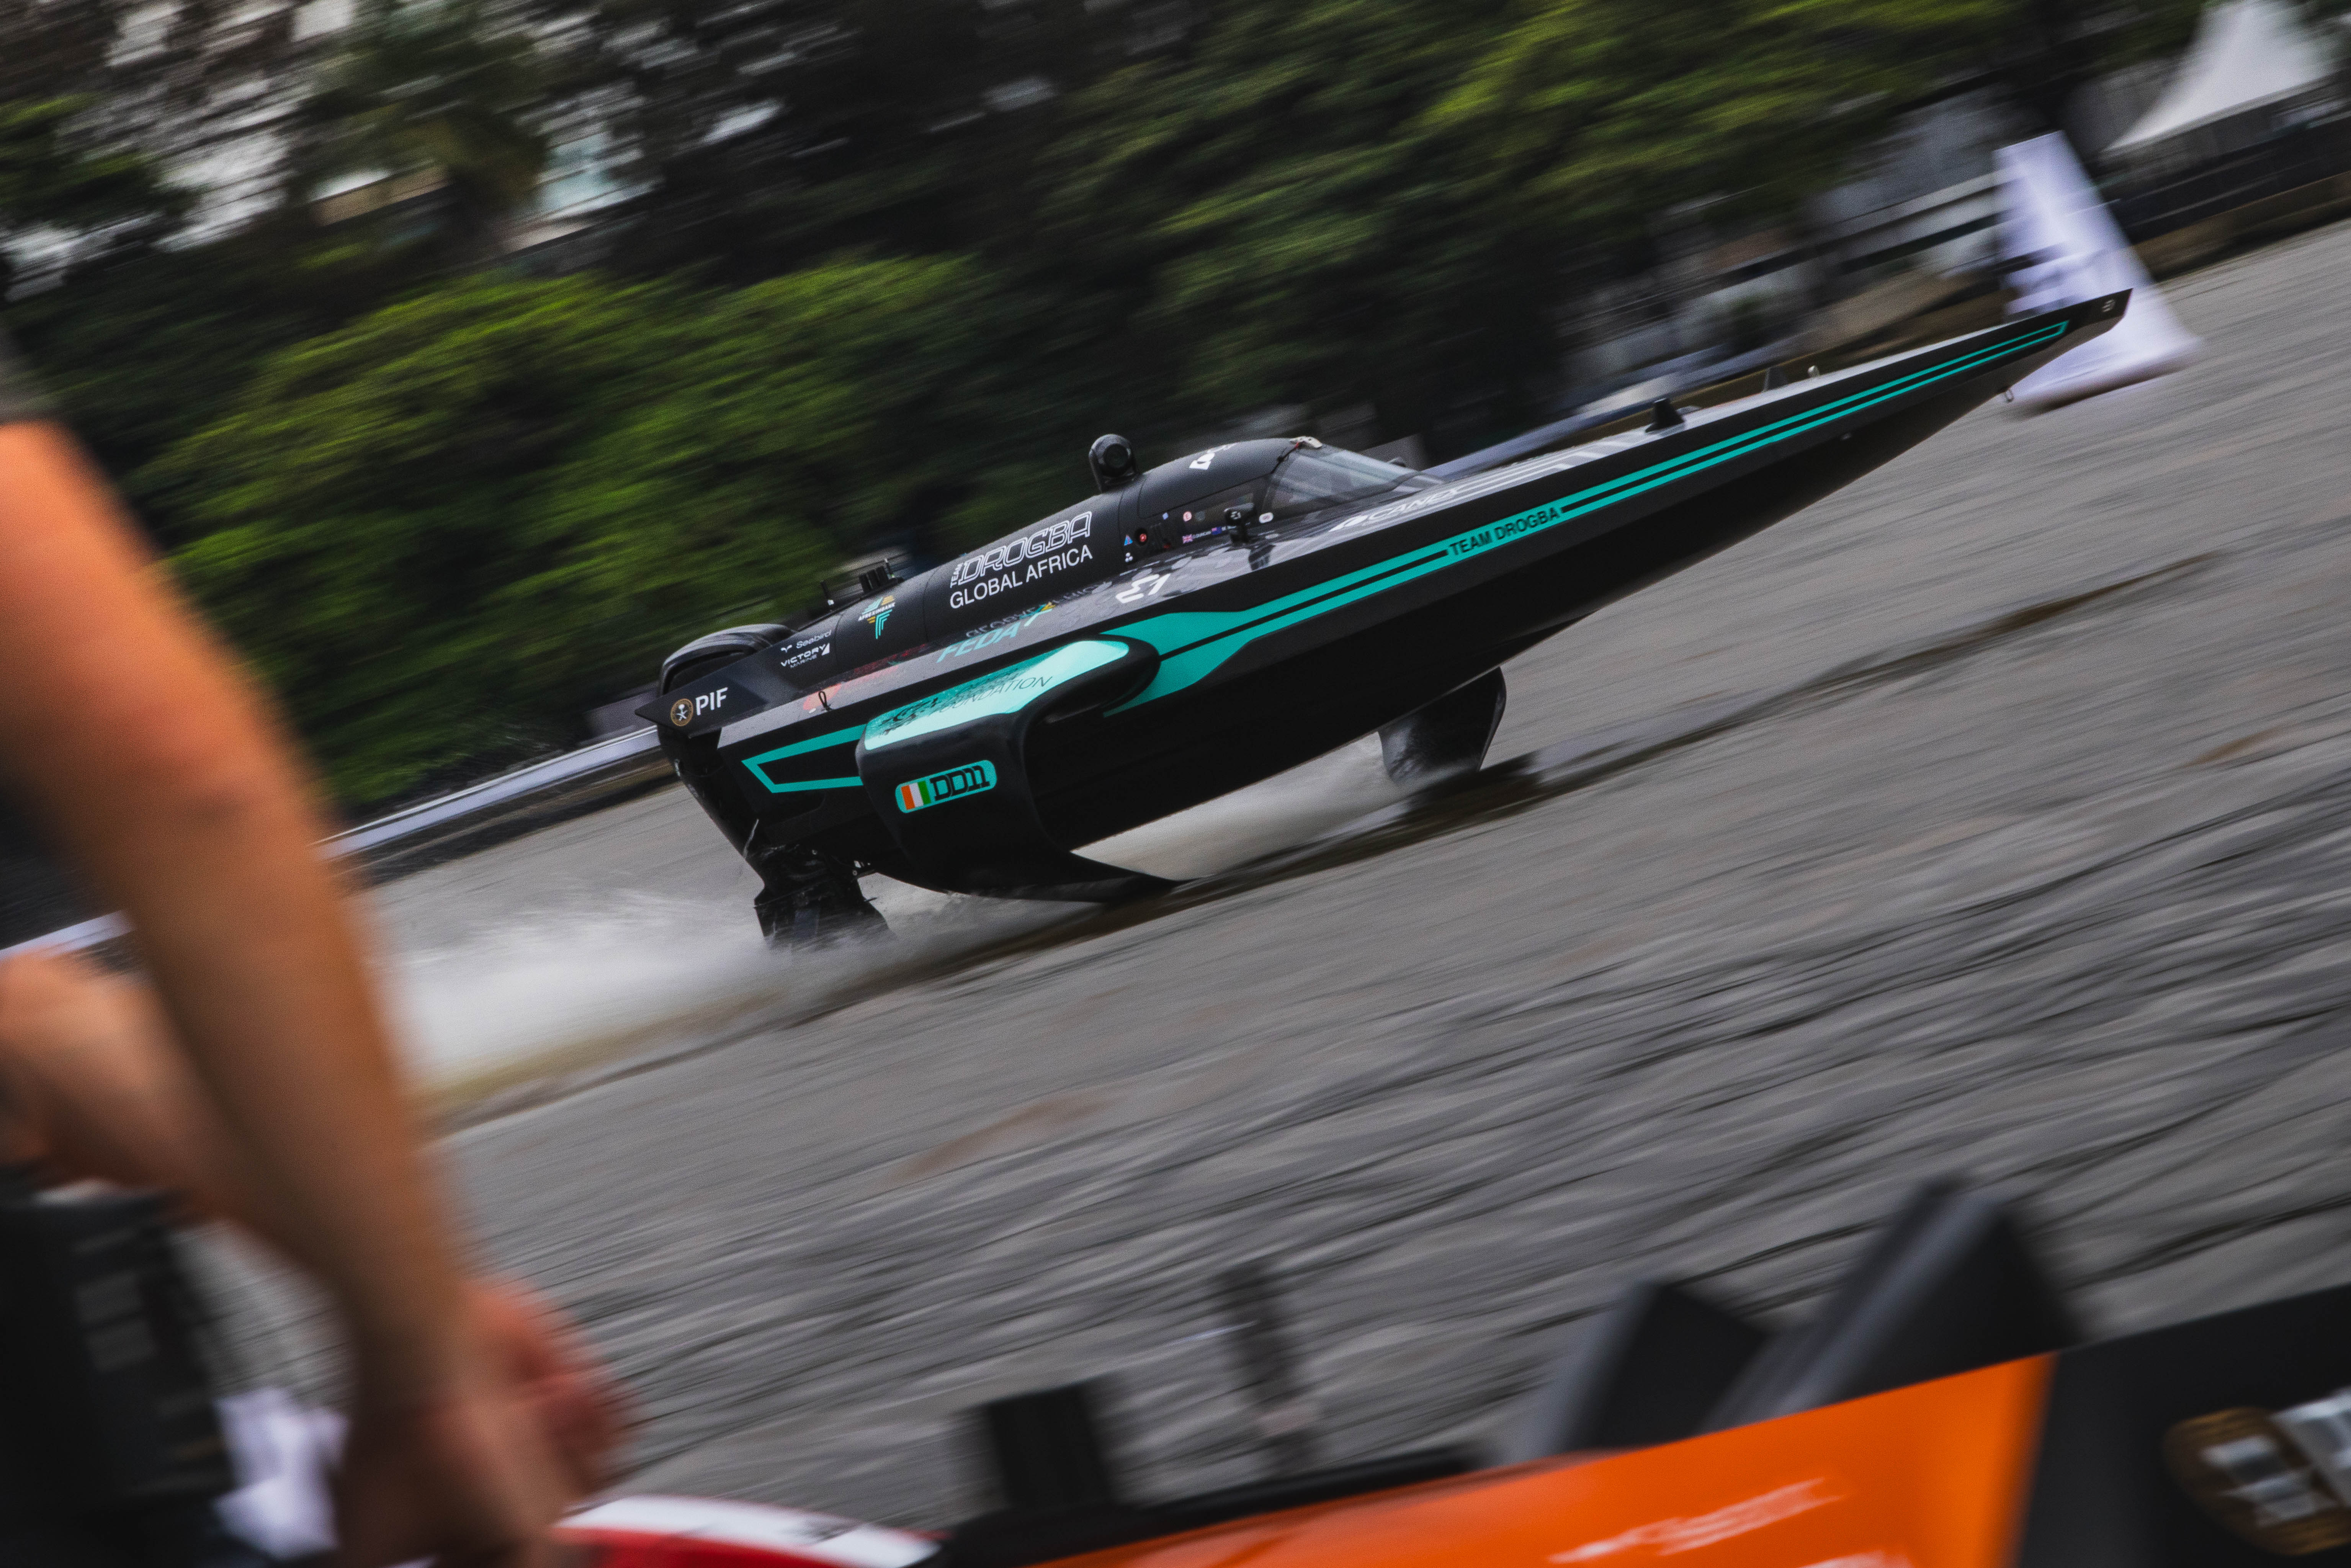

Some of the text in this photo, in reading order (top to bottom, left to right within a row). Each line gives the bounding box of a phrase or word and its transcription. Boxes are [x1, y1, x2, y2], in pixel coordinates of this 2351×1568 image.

[1449, 507, 1560, 555] TEAM DROGBA
[958, 511, 1092, 585] DROGBA
[950, 563, 964, 589] TEAM
[950, 544, 1092, 609] GLOBAL AFRICA
[796, 629, 832, 649] Seabird
[937, 621, 1020, 663] FEDA
[781, 644, 826, 667] VICTORY
[790, 654, 817, 668] MARINE
[695, 687, 728, 716] PIF
[929, 765, 990, 801] DD11
